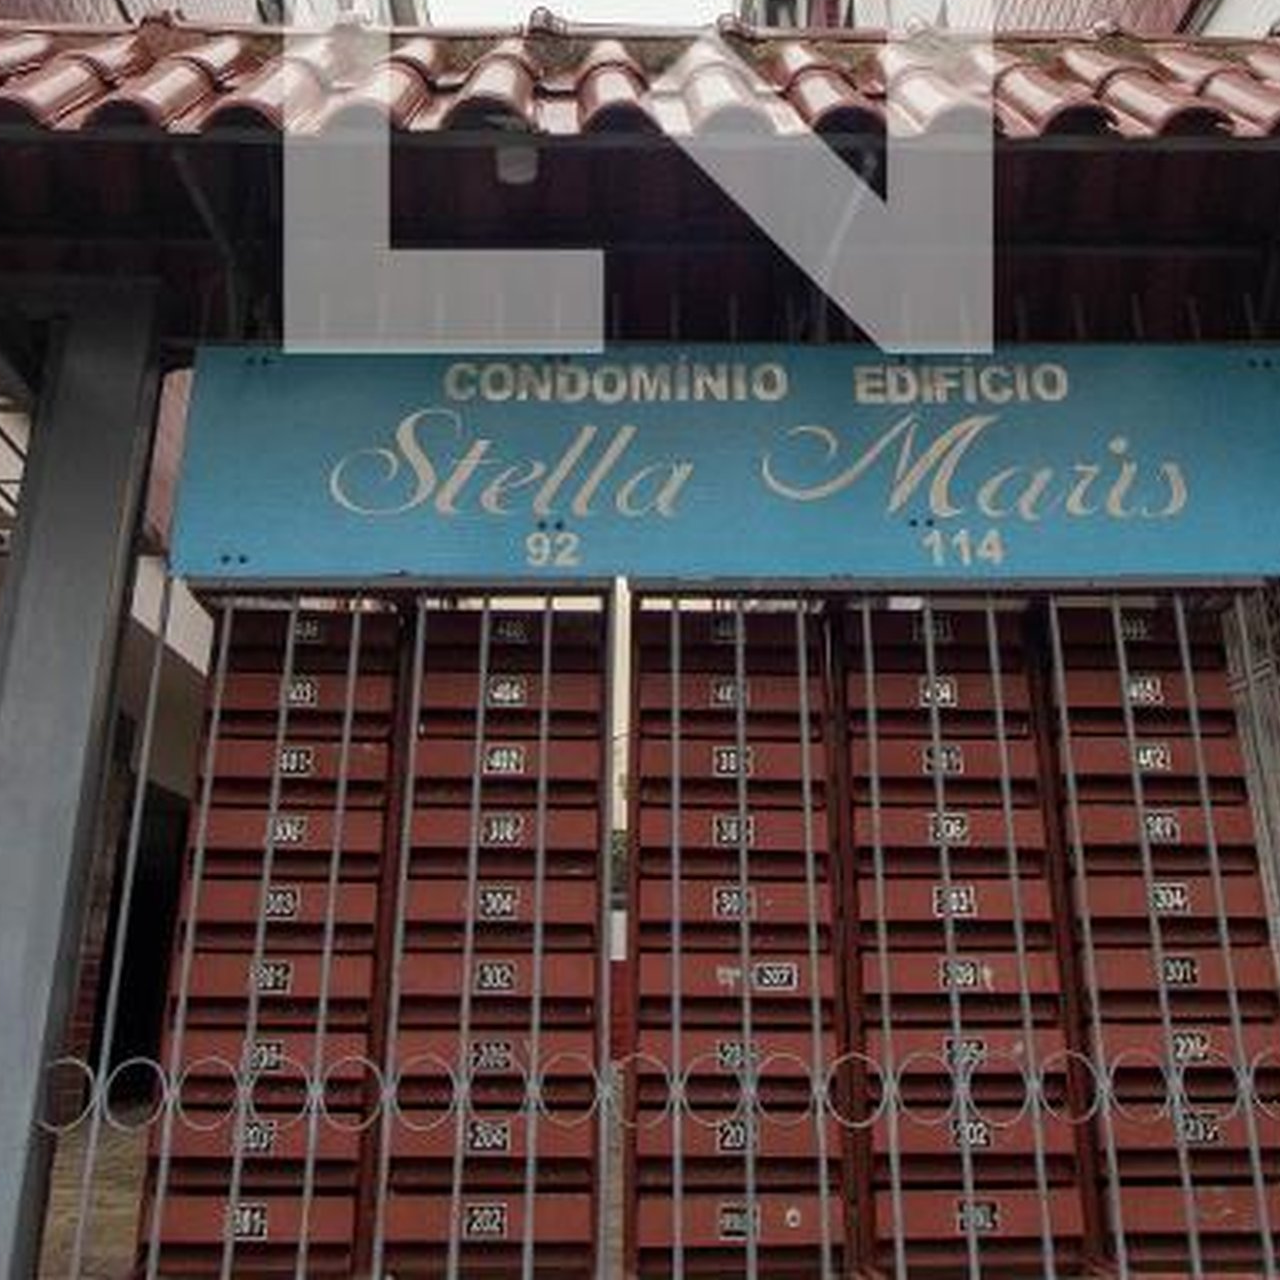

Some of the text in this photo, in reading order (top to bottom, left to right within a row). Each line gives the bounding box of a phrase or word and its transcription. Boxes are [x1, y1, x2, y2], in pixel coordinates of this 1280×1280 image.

[443, 354, 788, 404] CONDOMÍNIO
[329, 408, 1188, 521] Stella Maris
[525, 532, 580, 567] 92
[922, 528, 1008, 565] 114
[481, 965, 512, 989] 302
